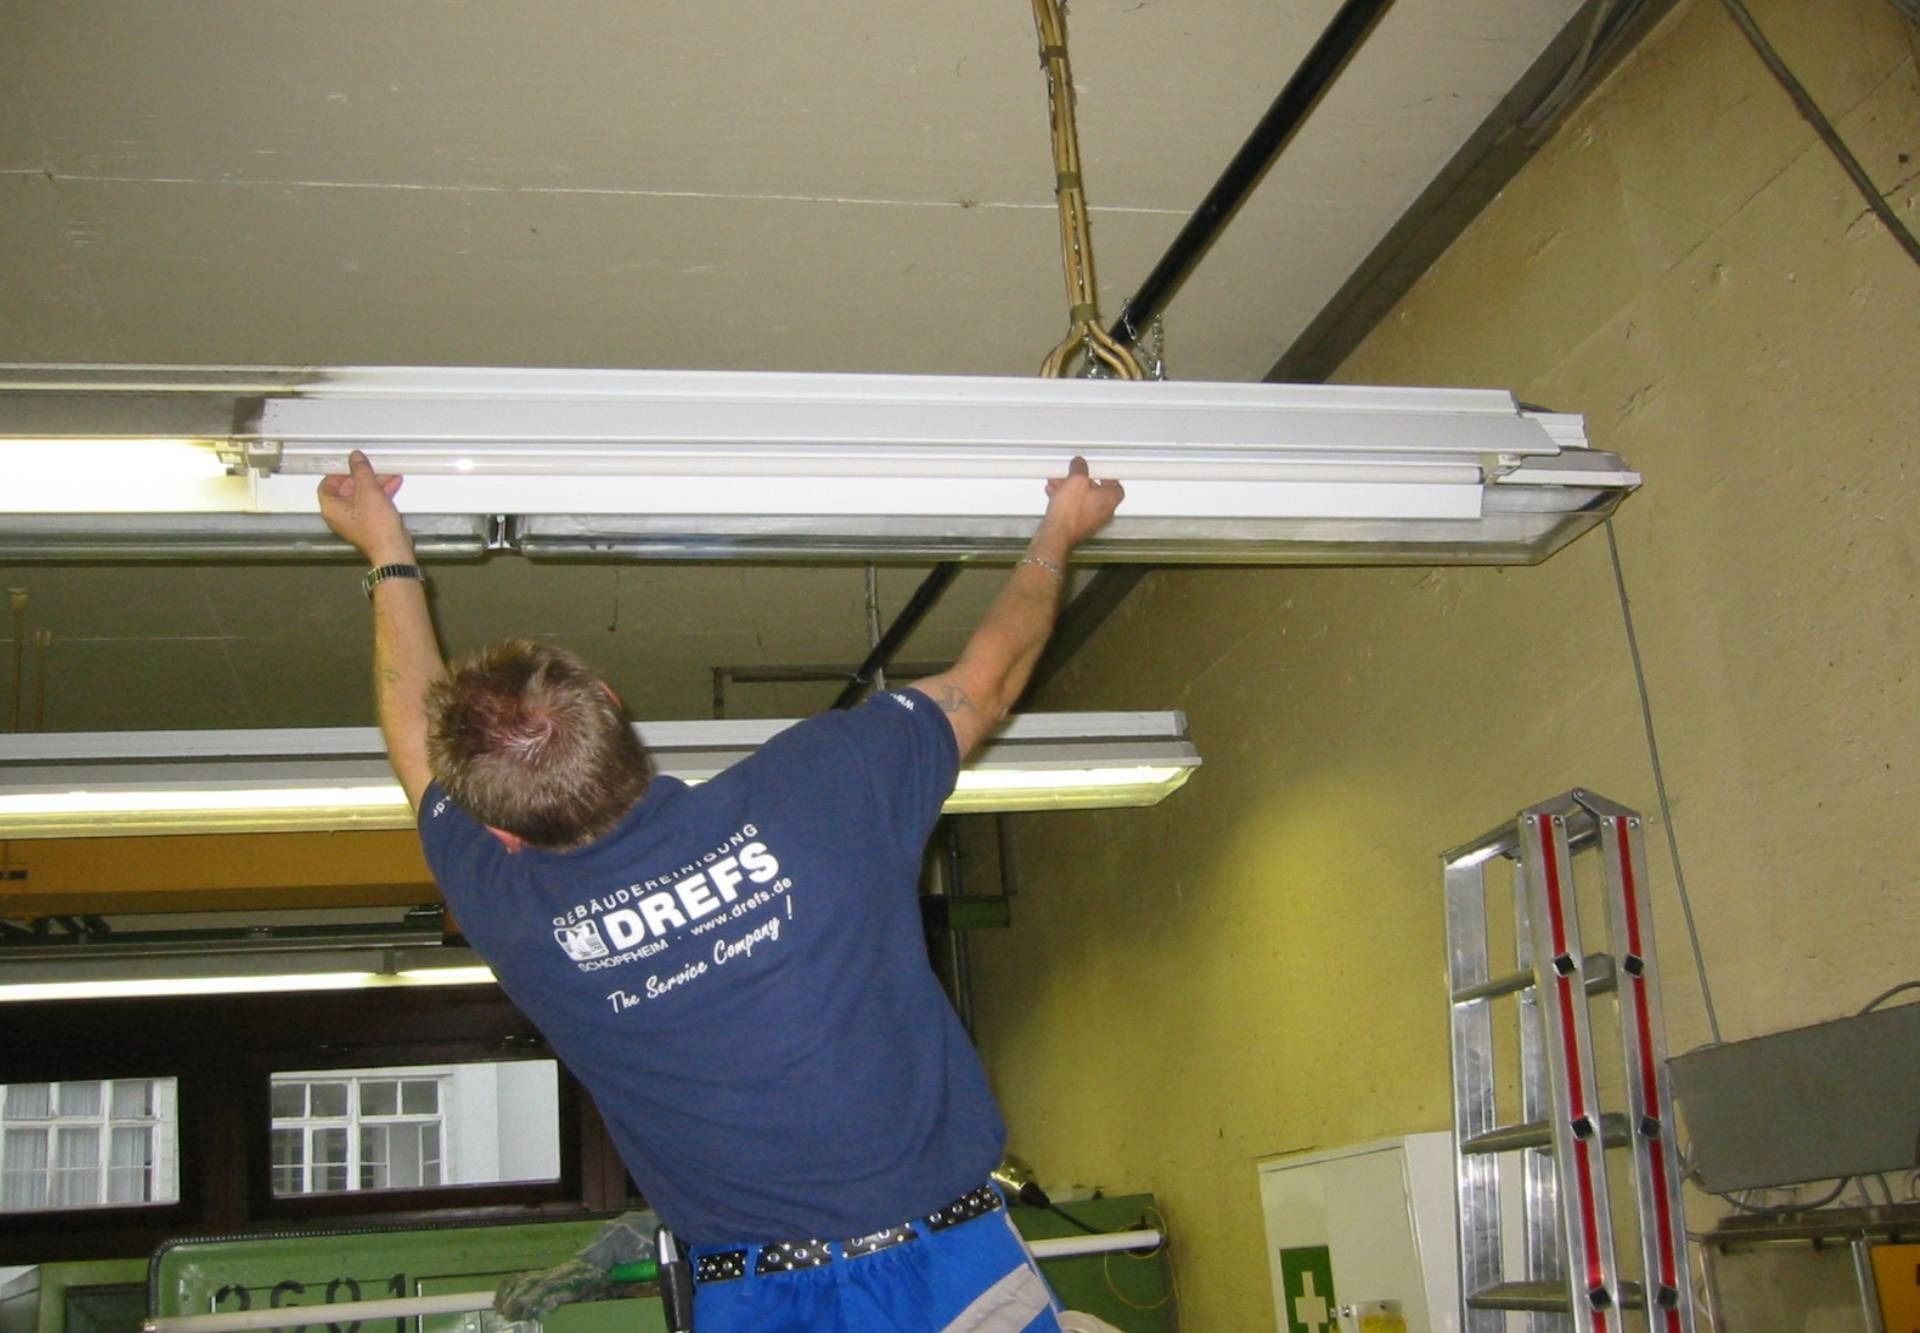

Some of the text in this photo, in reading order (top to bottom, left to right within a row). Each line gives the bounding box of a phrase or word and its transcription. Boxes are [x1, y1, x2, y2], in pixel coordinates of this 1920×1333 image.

[553, 823, 758, 926] GEBÄUDEREINIGUNG
[602, 841, 779, 950] DREFS
[578, 877, 792, 973] SCHOPFHEIM www.drefs.de
[607, 990, 640, 1014] The
[645, 961, 708, 999] Service
[714, 916, 780, 965] Company
